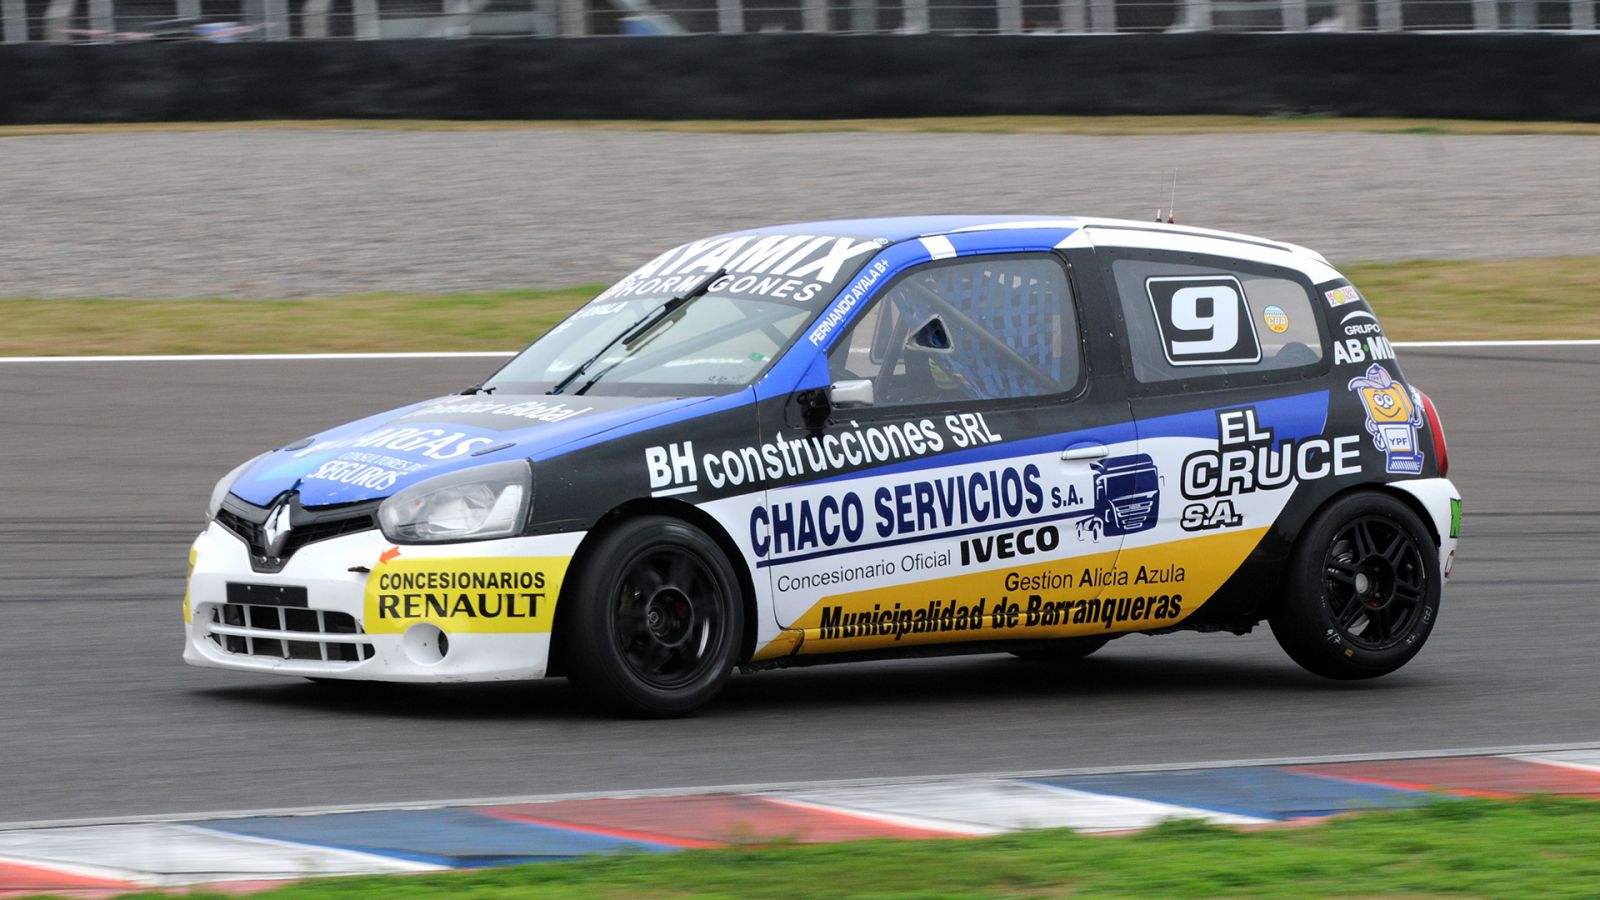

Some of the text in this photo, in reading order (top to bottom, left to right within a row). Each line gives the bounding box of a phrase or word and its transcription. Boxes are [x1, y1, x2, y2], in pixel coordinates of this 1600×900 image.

[614, 273, 823, 301] HORMGONES
[808, 294, 858, 346] FERNANDO
[851, 269, 881, 300] AYALA
[1171, 285, 1239, 355] 9
[1344, 323, 1381, 336] GRUPO
[492, 401, 593, 422] Global
[1219, 409, 1271, 446] EL
[1388, 437, 1408, 446] YPF
[645, 412, 1002, 489] BH construcciones SRL
[306, 460, 408, 490] SEGUROS
[1183, 435, 1362, 498] CRUCE
[750, 463, 1084, 558] CHACO SERVICIOS S.A.
[1181, 501, 1243, 530] S.A.
[777, 525, 1060, 594] Concesionario Oficial IVECO
[379, 571, 545, 591] CONCESIONARIOS
[1004, 564, 1186, 592] Gestion Alicia Azula
[379, 593, 545, 620] RENAULT
[819, 593, 1182, 641] Municipalidad de Barranqueras
